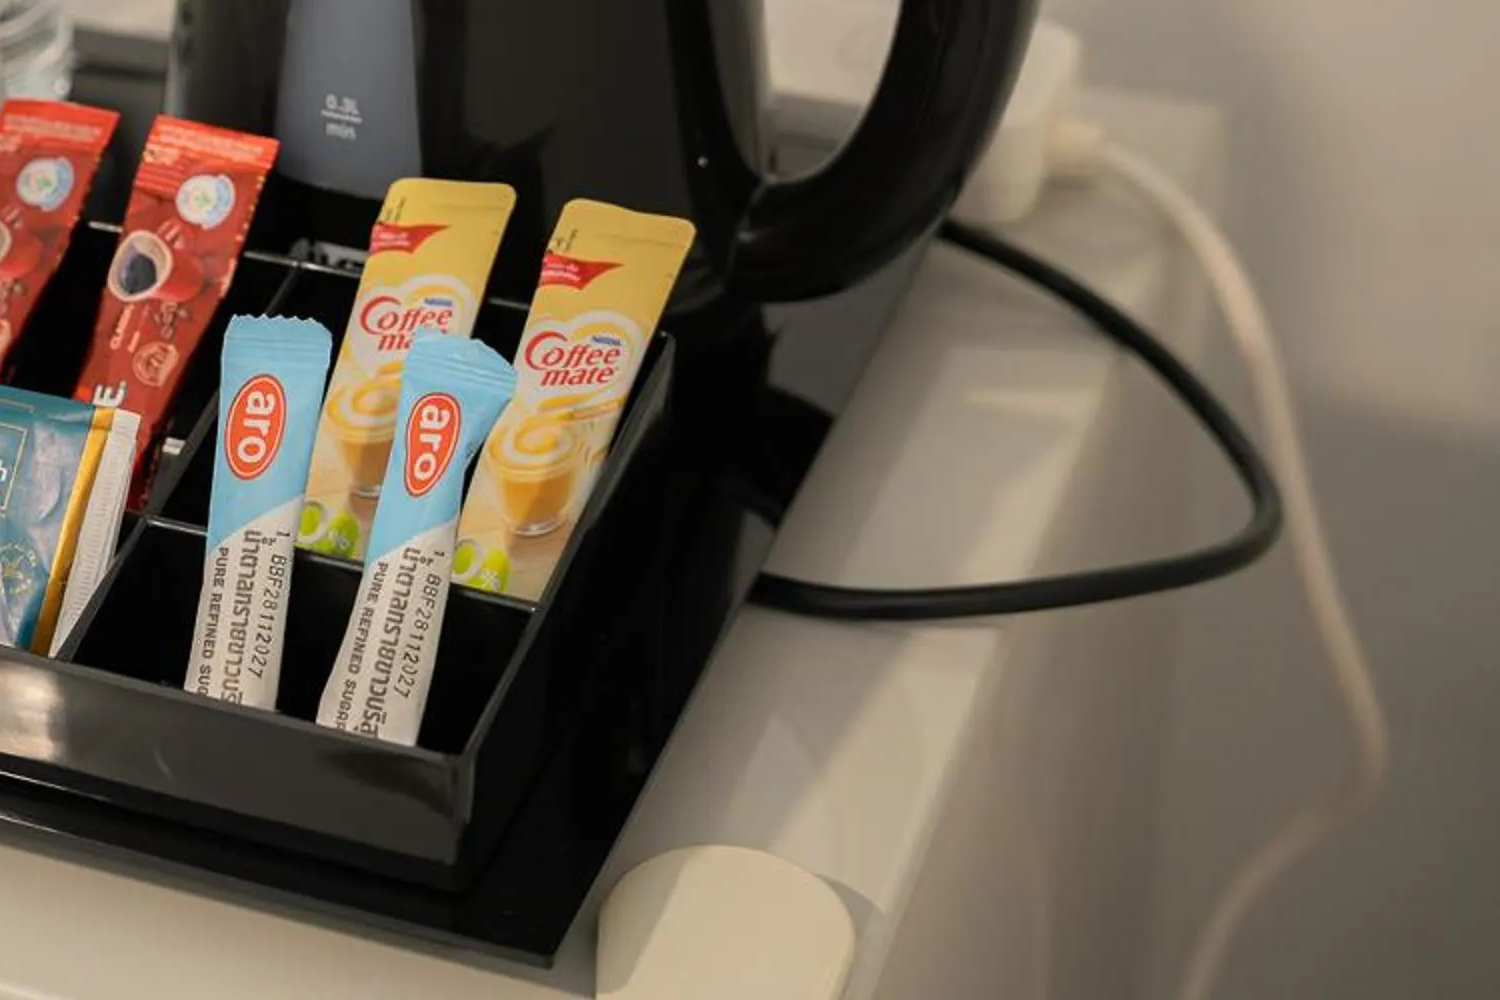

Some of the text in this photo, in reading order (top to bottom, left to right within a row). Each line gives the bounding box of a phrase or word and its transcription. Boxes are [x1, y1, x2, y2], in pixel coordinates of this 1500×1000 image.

[359, 296, 453, 334] Coffee
[525, 331, 620, 370] Coffee
[541, 366, 616, 386] mate
[237, 391, 276, 464] aro
[414, 404, 450, 481] aro
[213, 547, 229, 587] PURE
[367, 562, 389, 603] PURE
[202, 592, 222, 659] REFINED
[348, 607, 375, 675] REFINED
